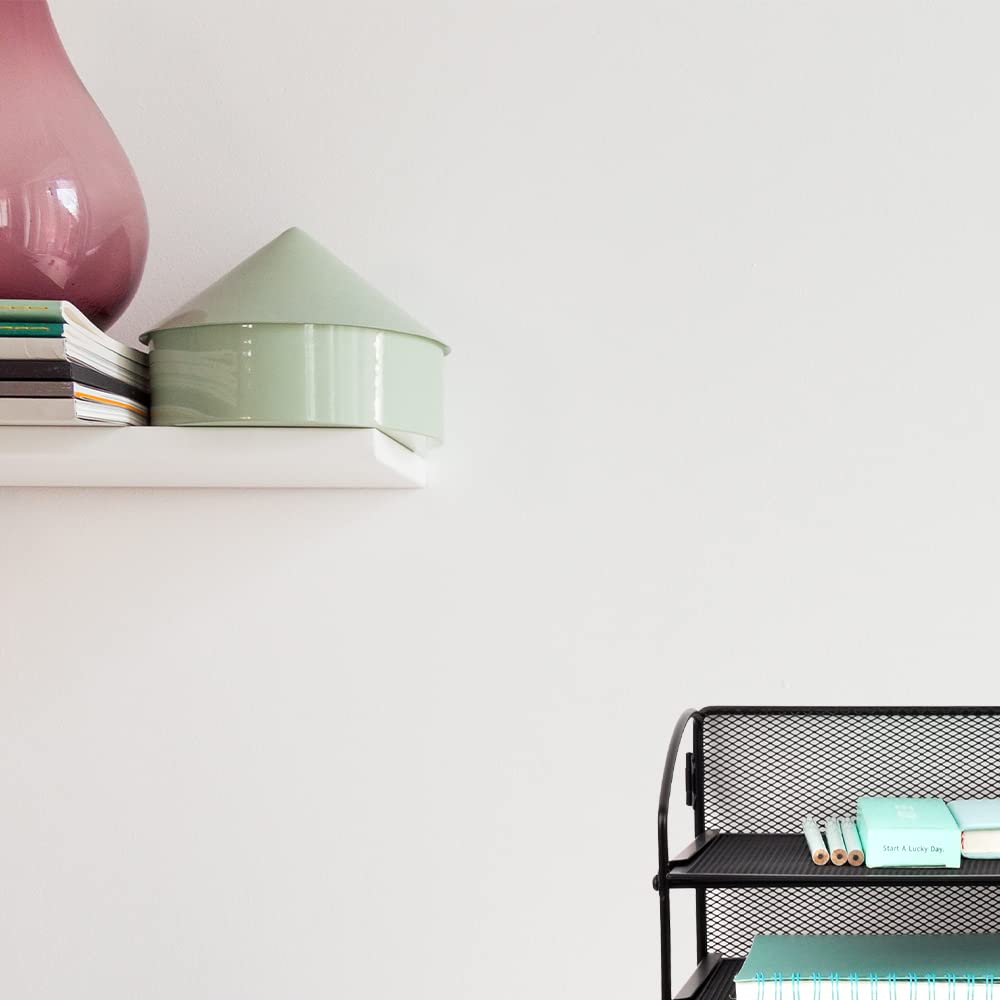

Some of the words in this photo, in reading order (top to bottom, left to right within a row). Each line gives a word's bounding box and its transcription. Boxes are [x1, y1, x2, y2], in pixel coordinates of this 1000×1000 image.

[883, 844, 899, 852] Start
[908, 844, 928, 854] Lucky
[930, 845, 945, 854] Day.
